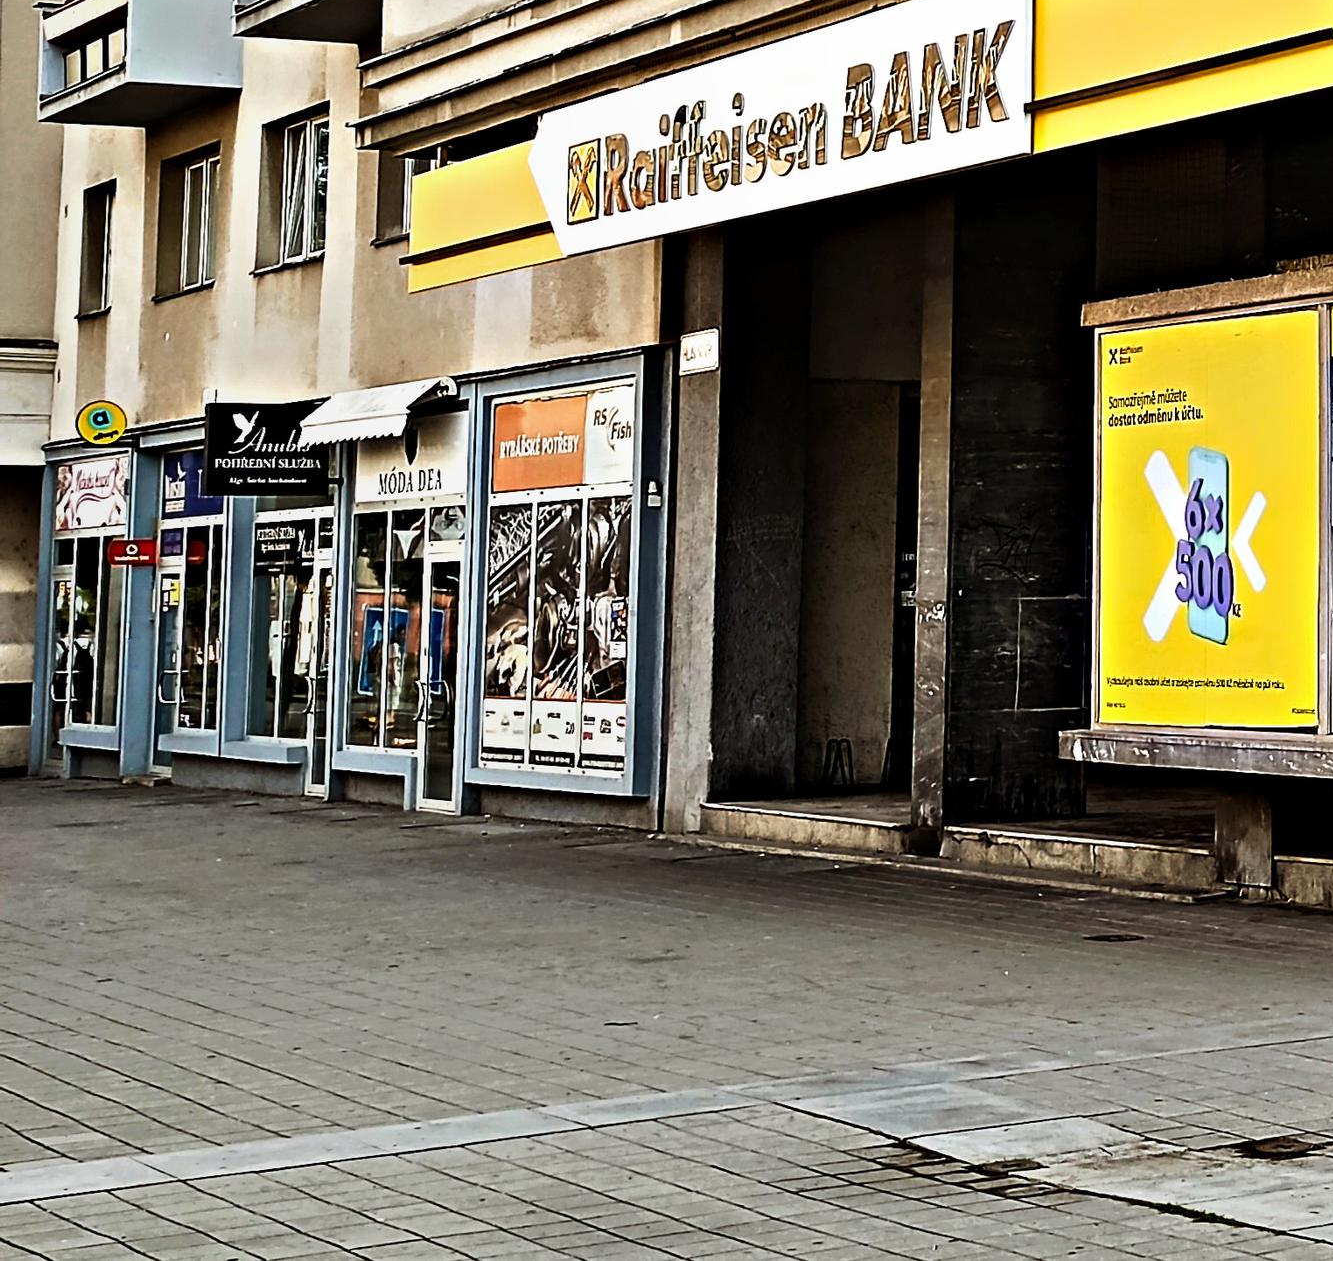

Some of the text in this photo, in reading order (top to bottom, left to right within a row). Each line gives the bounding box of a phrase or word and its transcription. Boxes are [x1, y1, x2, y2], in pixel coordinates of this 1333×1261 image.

[603, 20, 1017, 216] Raiffeisen BANK
[1109, 388, 1187, 409] Samozřejmě můžete
[593, 408, 607, 426] RS
[1109, 405, 1204, 427] dostat odměnu k účtu.
[610, 421, 632, 440] Fish
[499, 431, 580, 459] RYBÁŘSKÉ POTŘEBY
[278, 456, 321, 469] SLUŽBA
[378, 466, 442, 495] MÓDA DEA
[1185, 478, 1224, 539] 6x
[1175, 539, 1234, 617] 500
